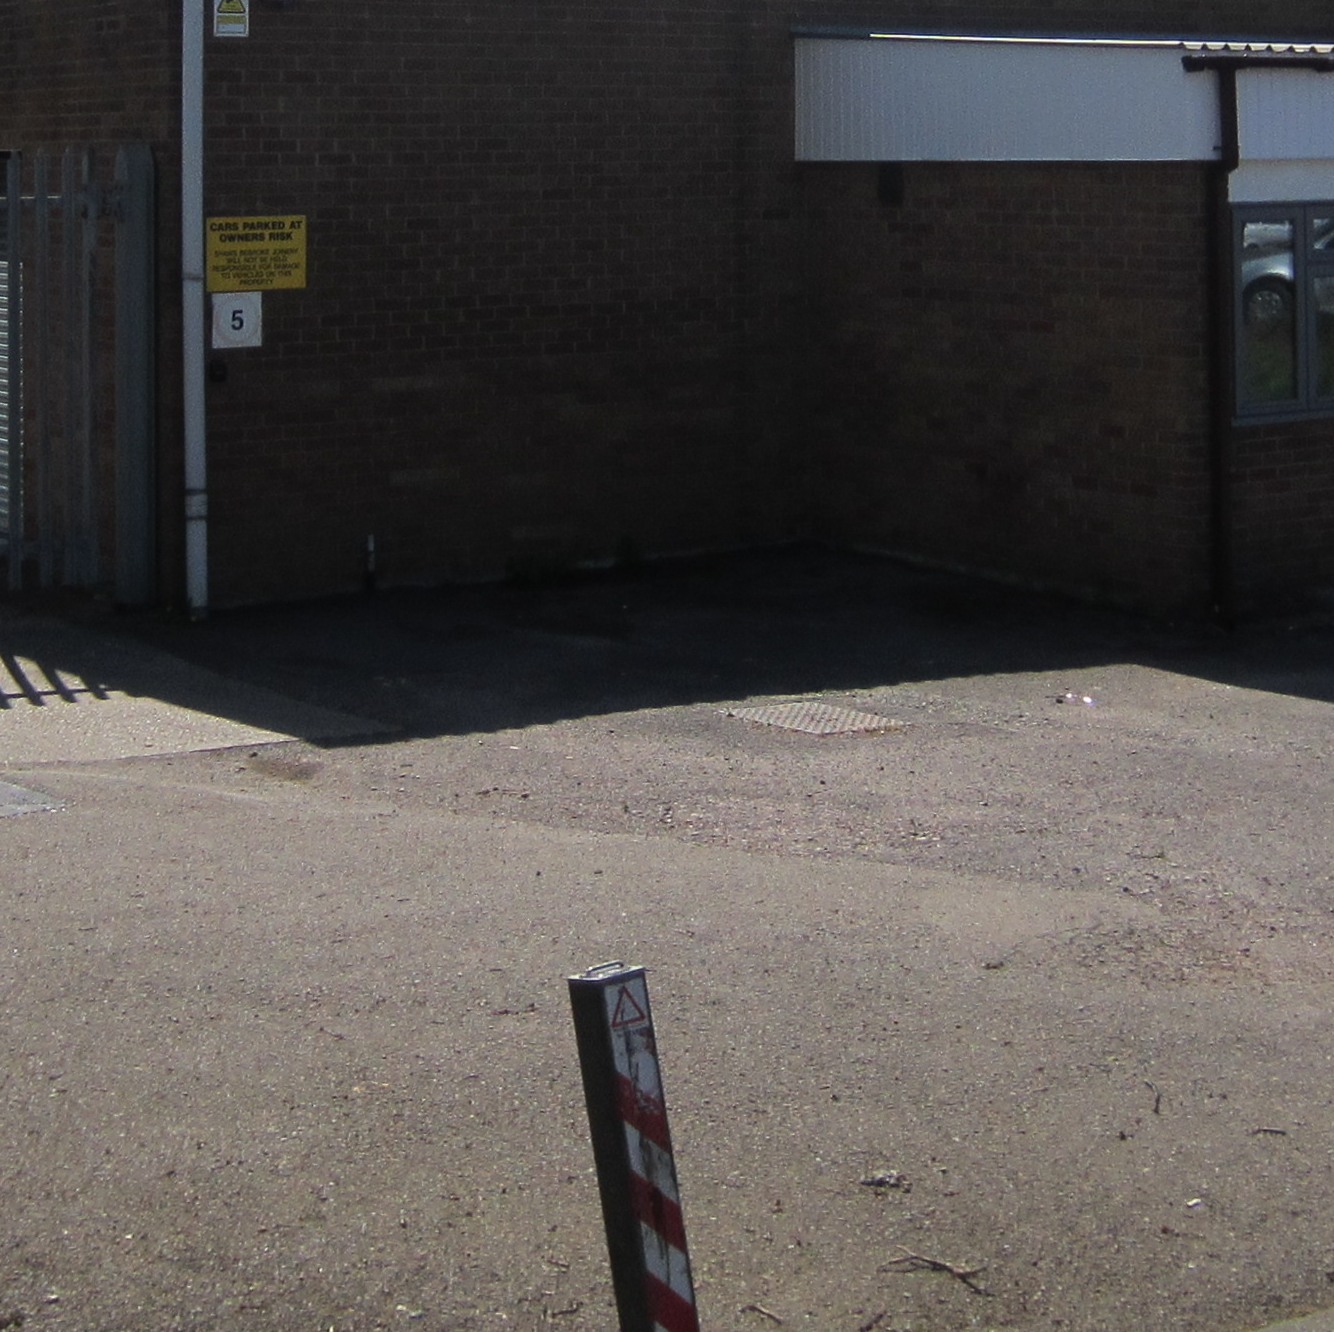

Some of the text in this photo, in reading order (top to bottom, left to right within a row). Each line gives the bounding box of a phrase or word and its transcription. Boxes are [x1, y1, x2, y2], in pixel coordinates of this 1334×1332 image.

[210, 220, 303, 231] CARS PARKED AT
[219, 231, 293, 243] OWNERS RISK
[231, 309, 244, 330] 5
